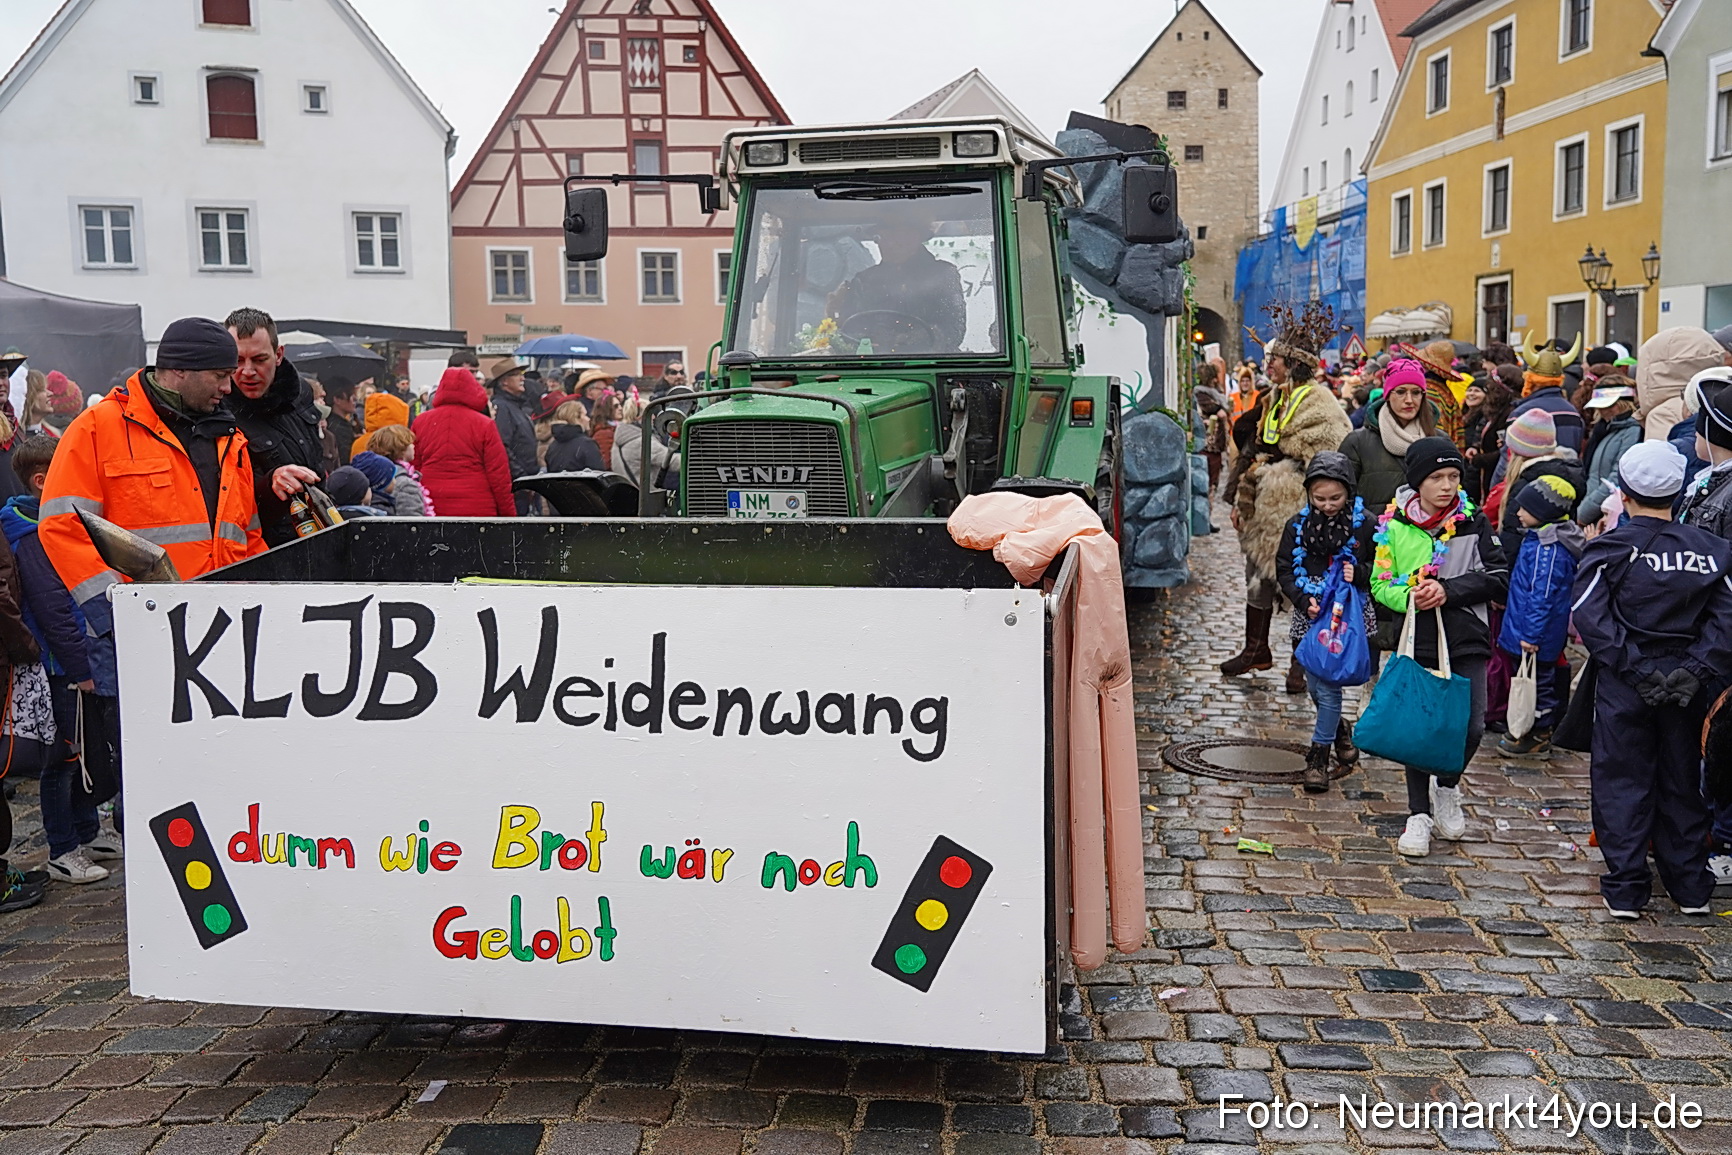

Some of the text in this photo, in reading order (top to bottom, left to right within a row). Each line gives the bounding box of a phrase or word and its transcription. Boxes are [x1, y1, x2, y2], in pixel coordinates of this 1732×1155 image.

[716, 466, 815, 483] FENDT
[745, 493, 770, 510] NM
[167, 594, 949, 763] KLJB Weidenwang
[228, 801, 879, 893] dumm wie Brot wär noch
[433, 895, 618, 965] Gelobt
